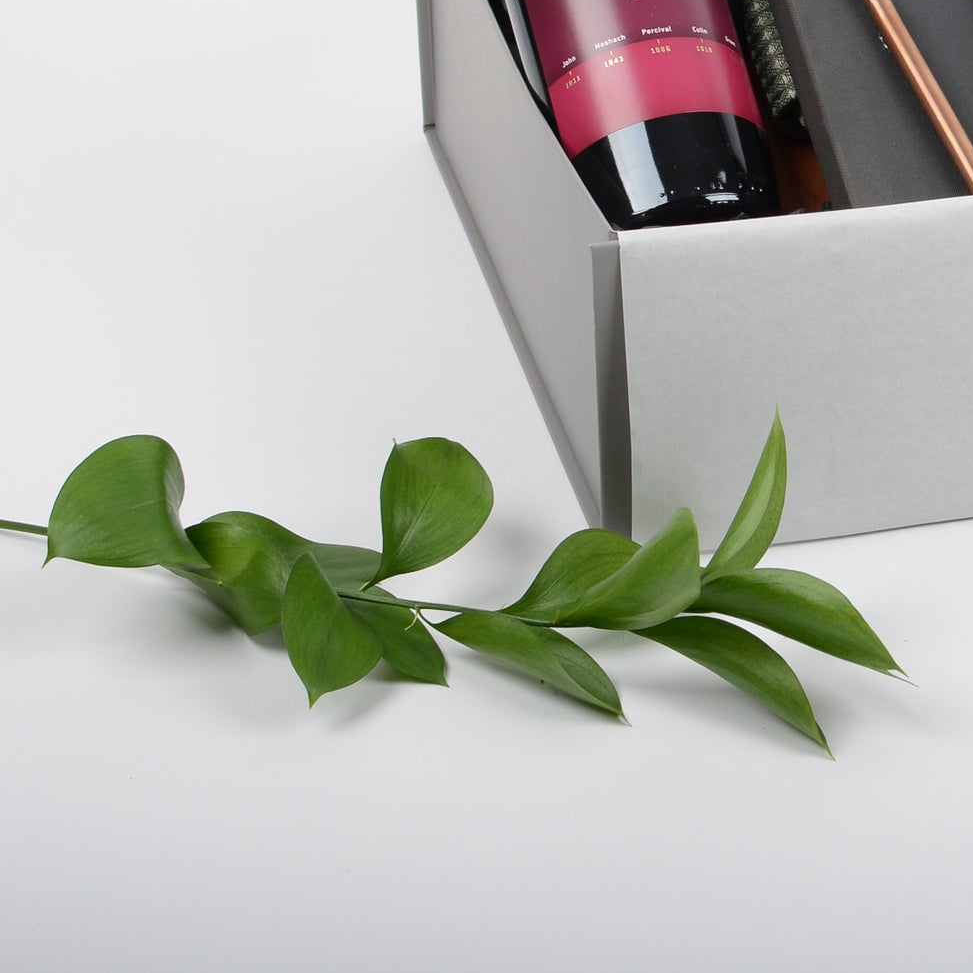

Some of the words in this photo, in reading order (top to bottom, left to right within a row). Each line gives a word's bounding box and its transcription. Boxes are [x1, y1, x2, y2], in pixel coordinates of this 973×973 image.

[562, 55, 577, 69] John
[594, 34, 626, 50] Meshach
[641, 25, 672, 36] Percival
[692, 26, 708, 35] Colin
